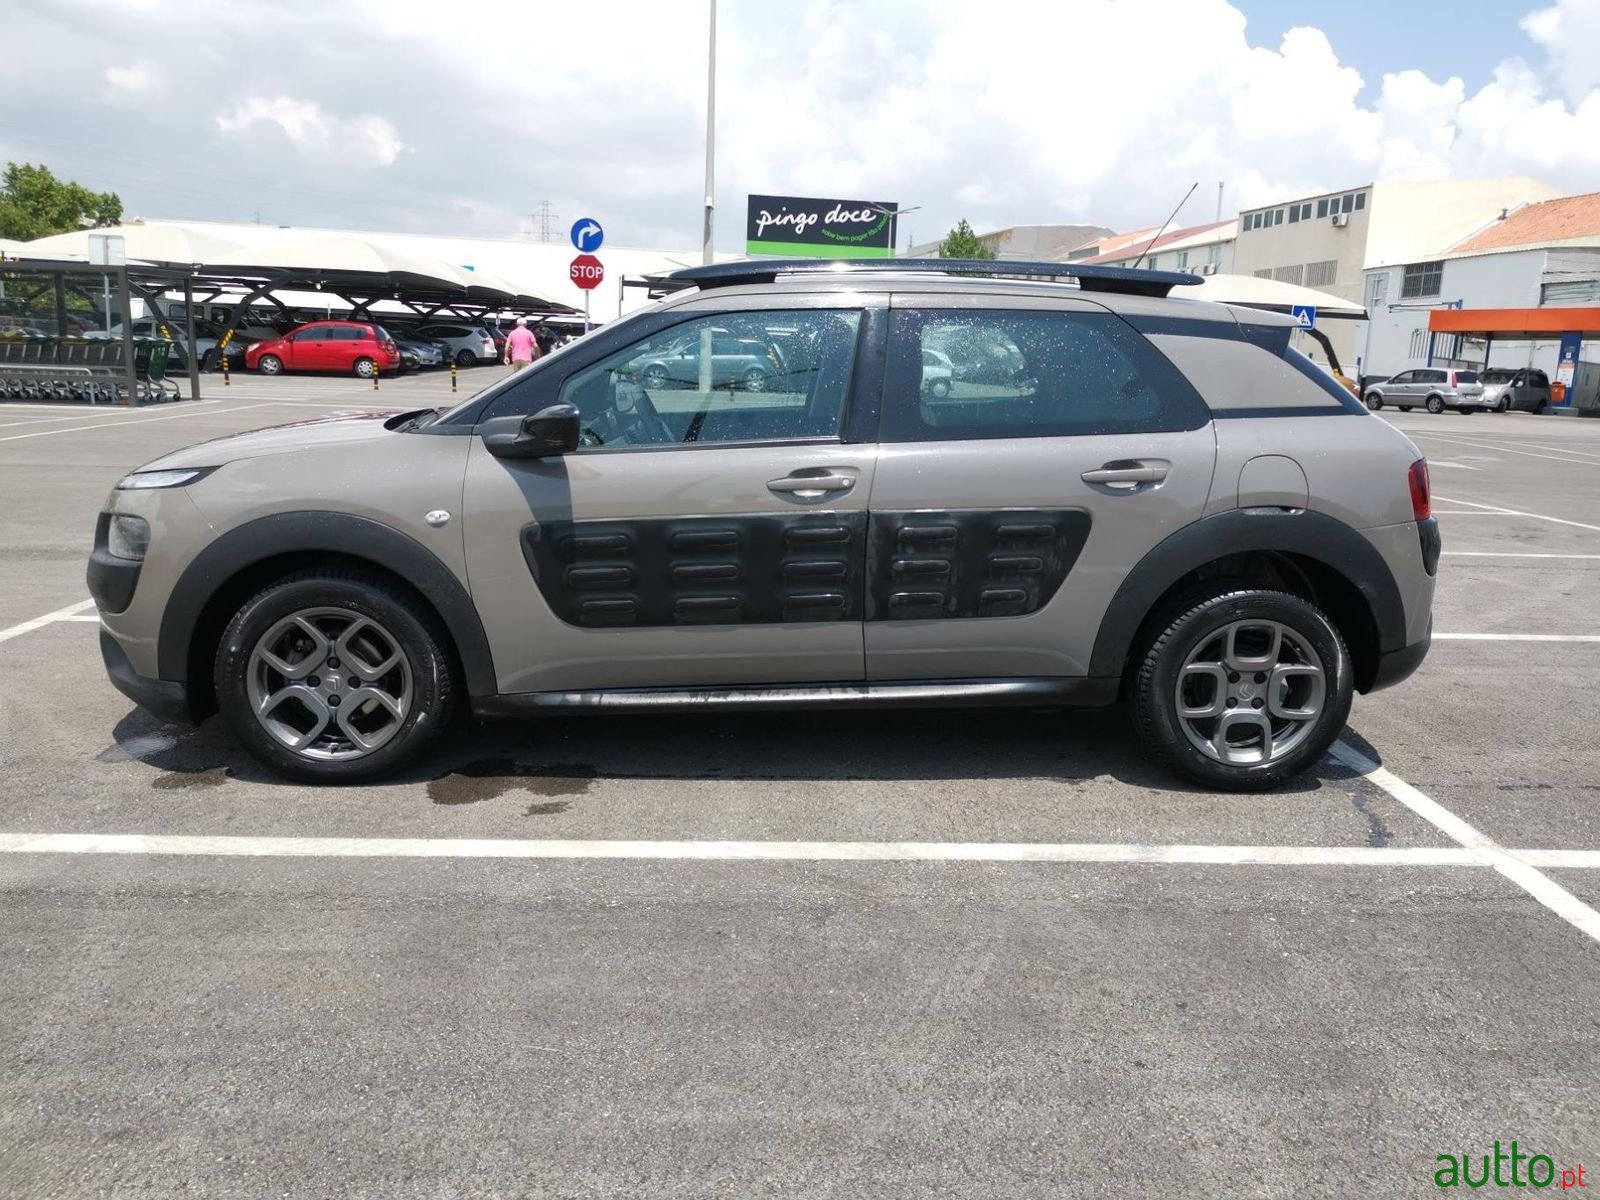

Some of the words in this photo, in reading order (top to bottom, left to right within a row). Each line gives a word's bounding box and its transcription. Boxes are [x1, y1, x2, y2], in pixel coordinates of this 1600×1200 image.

[756, 206, 818, 237] pingo
[824, 203, 877, 224] doce
[571, 265, 603, 279] STOP
